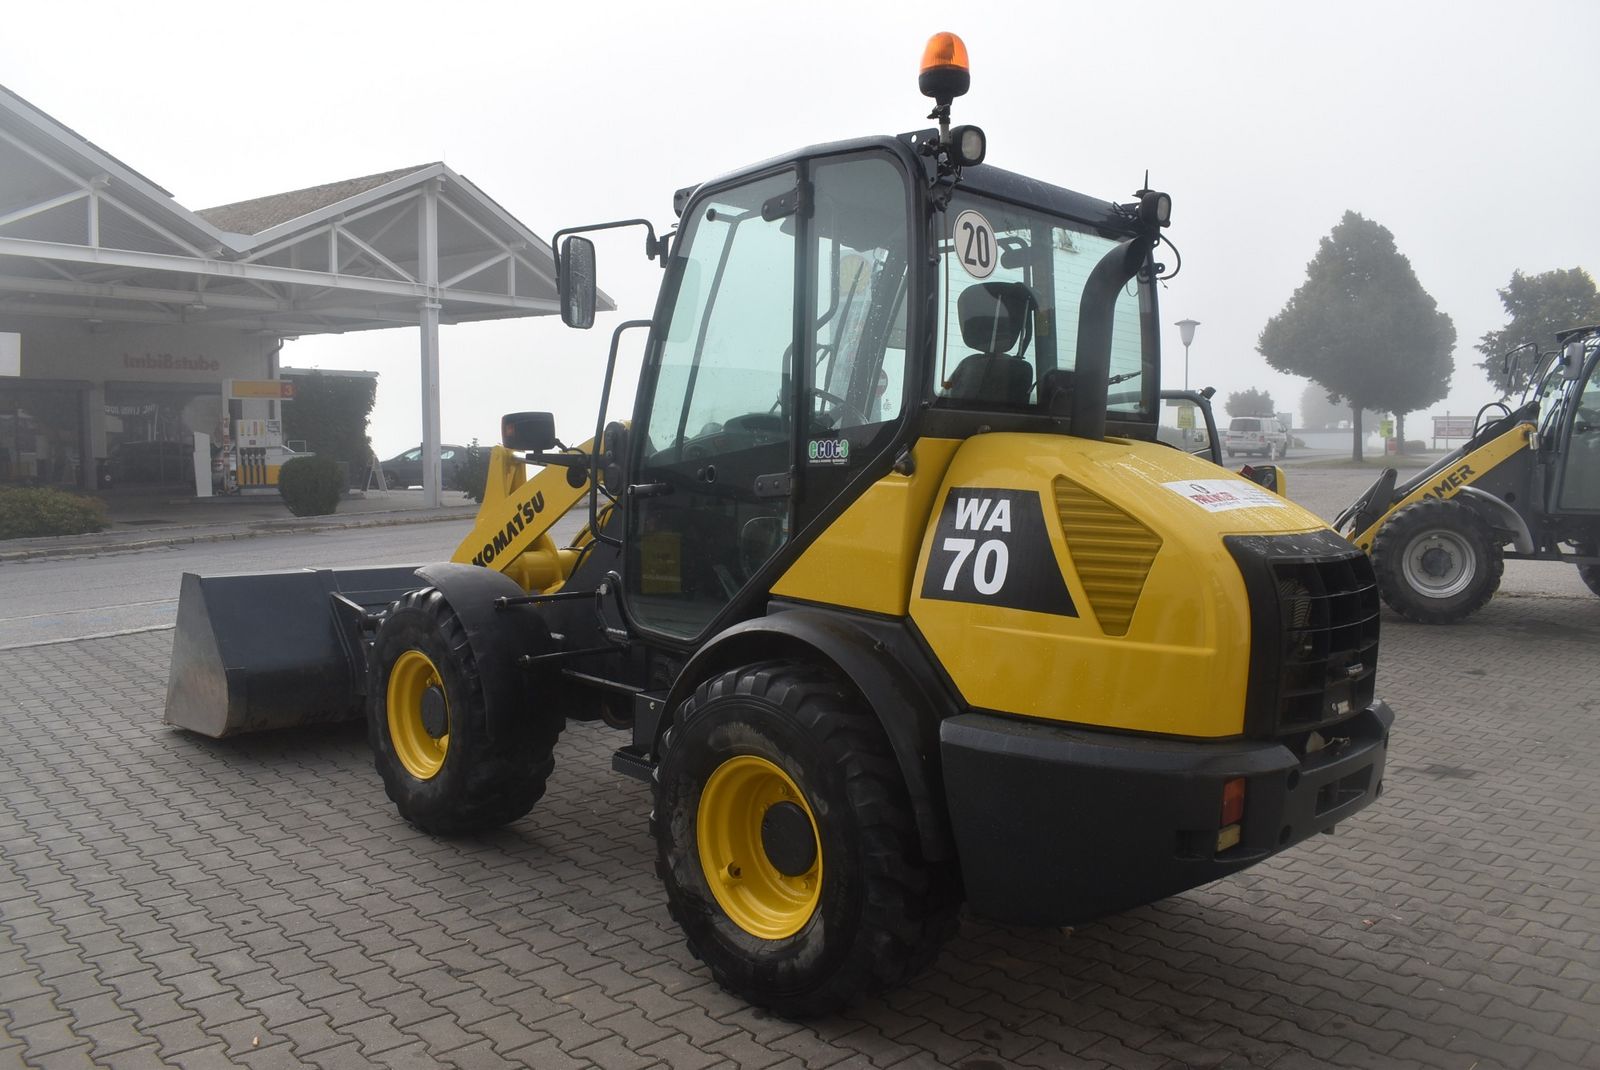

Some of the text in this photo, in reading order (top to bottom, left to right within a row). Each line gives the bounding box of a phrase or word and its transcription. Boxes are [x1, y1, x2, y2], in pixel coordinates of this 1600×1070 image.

[963, 221, 990, 268] 20
[284, 383, 293, 396] 3
[809, 439, 849, 459] ecot3
[1423, 464, 1475, 500] AMER
[472, 490, 545, 567] KOMATSU
[955, 497, 1011, 533] WA
[943, 537, 1009, 595] 70
